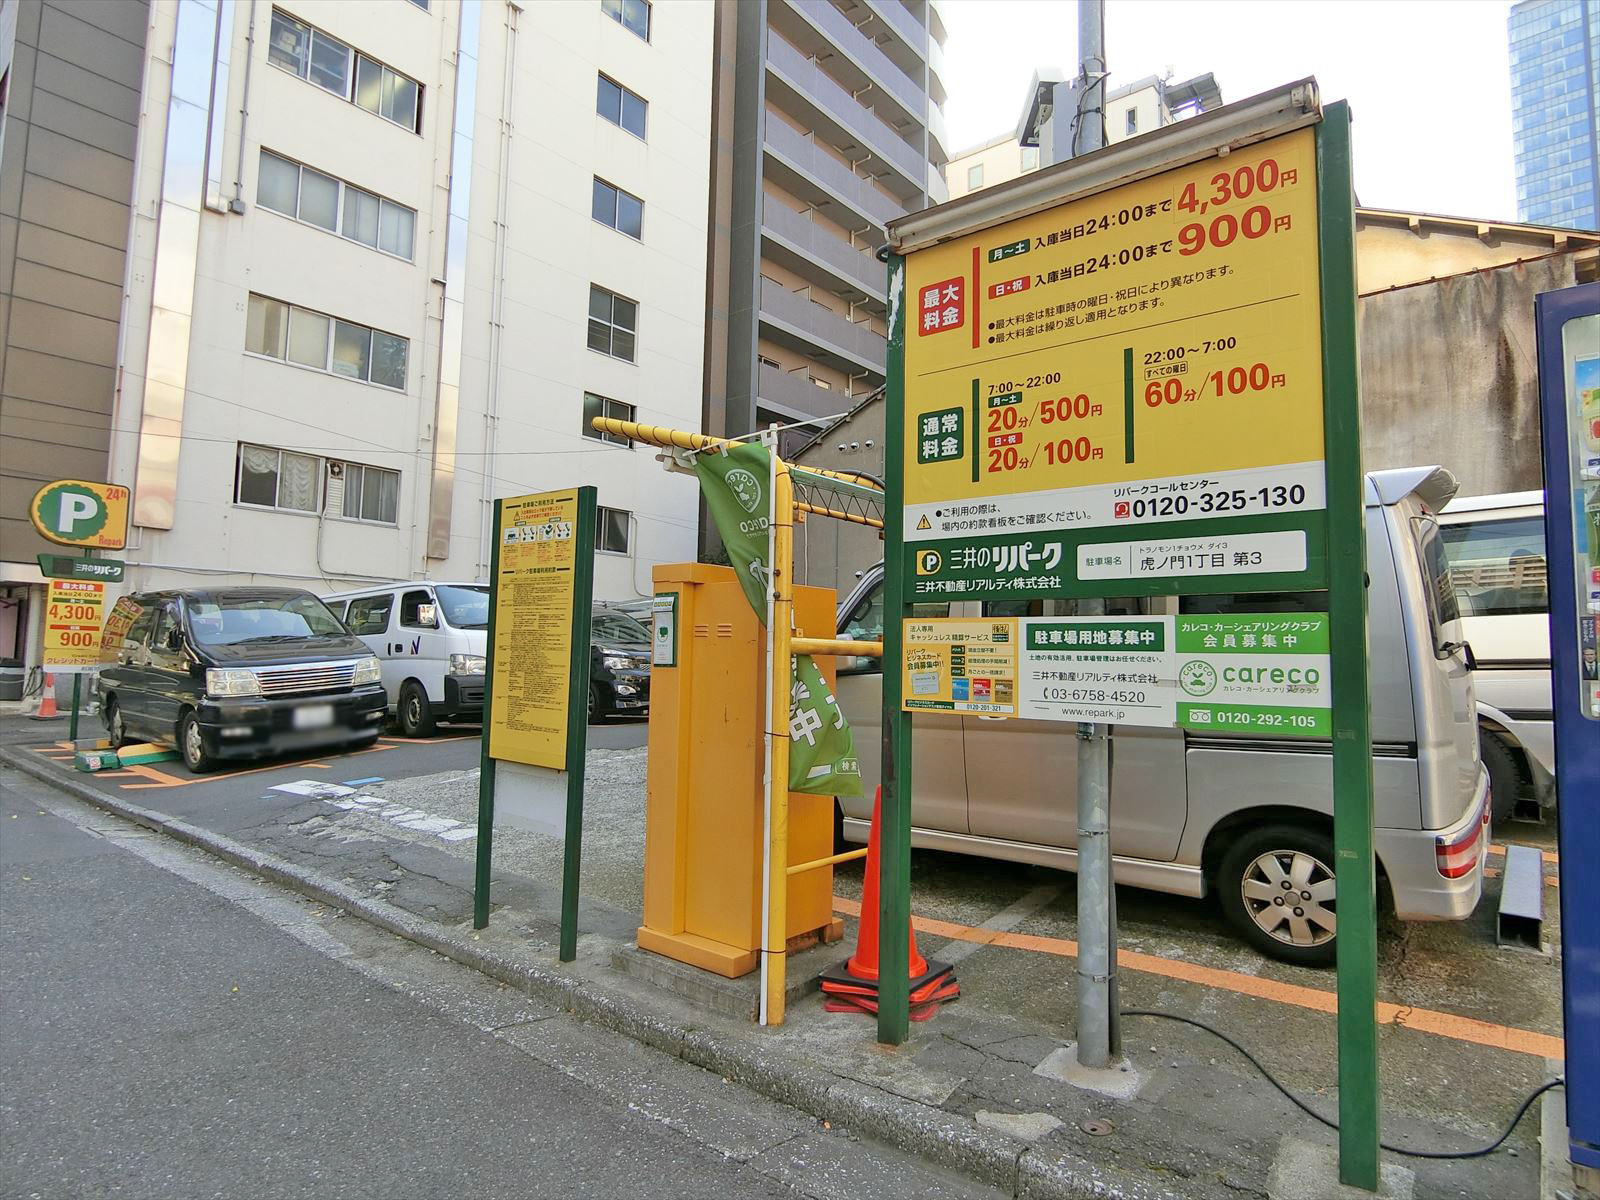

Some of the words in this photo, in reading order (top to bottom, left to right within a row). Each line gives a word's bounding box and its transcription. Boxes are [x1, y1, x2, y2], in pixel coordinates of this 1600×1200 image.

[923, 284, 960, 309] 最大
[923, 306, 960, 331] 料金
[1146, 363, 1187, 378] すべての曜日
[922, 413, 958, 437] 通常
[922, 436, 958, 459] 料金
[1113, 479, 1219, 498] リパークコールセンター
[1132, 484, 1306, 518] 0120-325-130
[58, 492, 98, 533] P
[949, 541, 1062, 573] 三井のリパーク
[1085, 556, 1122, 567] 駐車場名
[1140, 552, 1225, 571] 虎ノ門1丁目
[1233, 550, 1263, 567] 第3
[75, 563, 122, 576] 三井のリパーク
[915, 575, 1062, 593] 三井不動産リアルティ株式会社
[909, 625, 933, 633] 法人専用
[1034, 629, 1155, 646] 駐車場用地募集中
[906, 648, 926, 656] リパーク
[1033, 671, 1158, 684] 三井不動産リアルティ株式会社
[1183, 662, 1213, 677] careco
[1222, 666, 1320, 684] careco
[1051, 688, 1145, 703] 03-6758-4520
[1061, 707, 1126, 720] www.repark.jp
[1217, 711, 1316, 728] 0120-292-105
